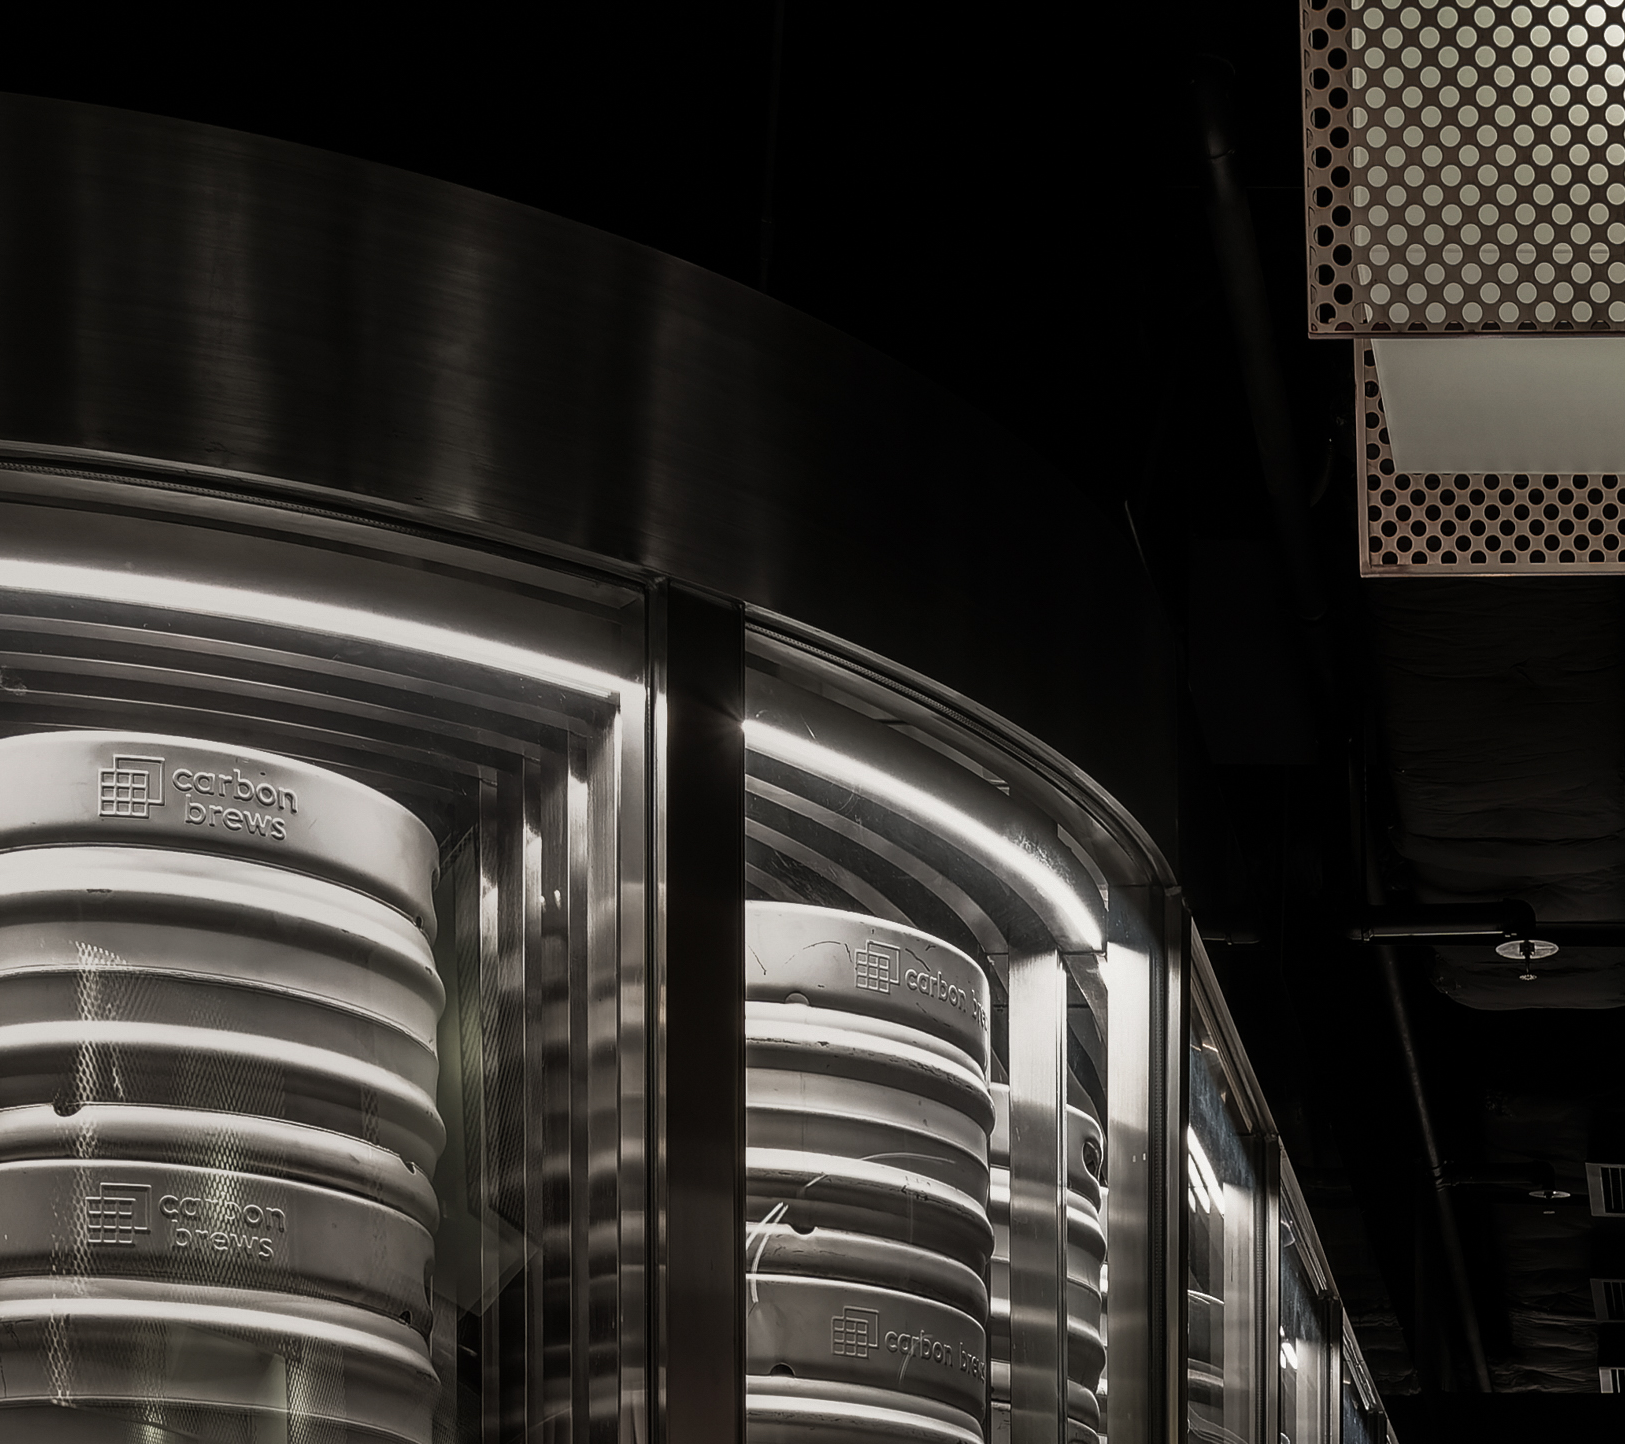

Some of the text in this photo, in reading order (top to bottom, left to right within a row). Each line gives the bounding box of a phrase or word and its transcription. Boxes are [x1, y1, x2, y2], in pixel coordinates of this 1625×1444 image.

[172, 768, 299, 813] carbon
[184, 794, 287, 841] brews
[905, 968, 967, 1013] carbon
[158, 1193, 286, 1233] carbon
[171, 1219, 274, 1259] brews
[884, 1330, 953, 1367] carbon
